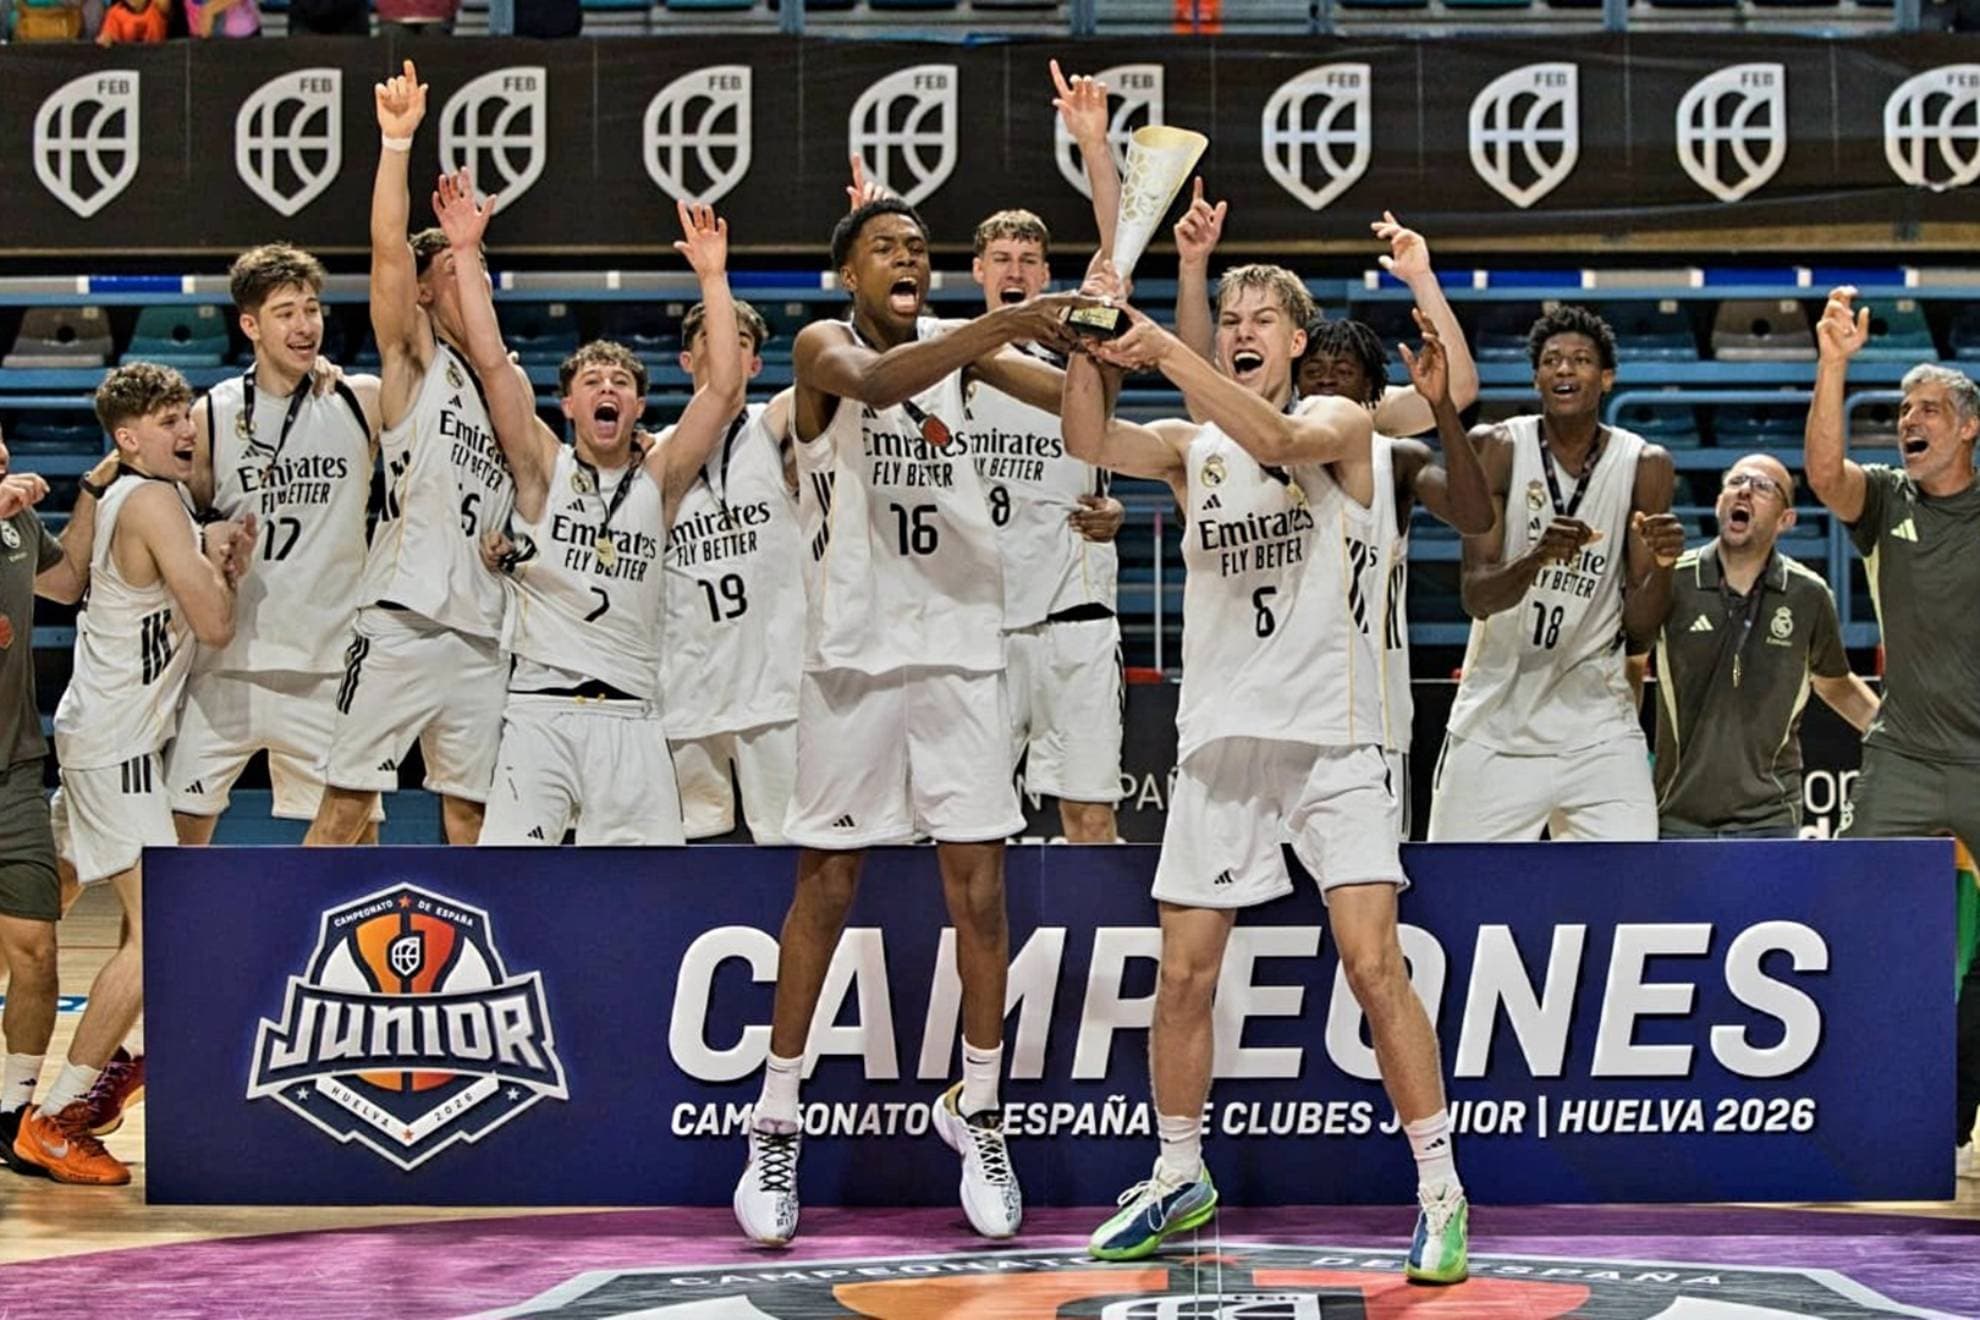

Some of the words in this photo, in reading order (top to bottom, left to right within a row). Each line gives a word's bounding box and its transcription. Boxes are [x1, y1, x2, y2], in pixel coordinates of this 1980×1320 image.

[97, 79, 130, 95] FEB
[299, 77, 333, 93] FEB
[503, 75, 537, 91] FEB
[708, 74, 742, 90] FEB
[914, 74, 948, 89] FEB
[1120, 73, 1154, 89] FEB
[1327, 73, 1361, 88] FEB
[1534, 72, 1568, 87] FEB
[1741, 71, 1775, 87] FEB
[969, 428, 1063, 458] mirates
[872, 461, 901, 486] FLY
[989, 457, 1044, 481] BETTER
[989, 485, 1010, 528] 8
[264, 516, 301, 561] 17
[552, 514, 656, 560] Emrates
[669, 502, 770, 546] mirates
[890, 502, 938, 556] 16
[564, 548, 593, 572] FLY
[677, 543, 697, 567] FLY
[703, 530, 757, 562] BETTER
[1221, 548, 1249, 577] FLY
[697, 573, 748, 622] 19
[1252, 586, 1277, 638] 6
[1533, 601, 1564, 650] 18
[334, 899, 394, 928] CAMPEONATO
[417, 899, 432, 912] DE
[331, 1086, 391, 1128] HUELVA
[434, 1092, 473, 1121] 2026
[671, 1102, 929, 1136] CAMONATO
[1003, 1095, 1151, 1136] ESPAÑA
[1221, 1101, 1372, 1135] CLUBES
[1379, 1100, 1524, 1135] JIOR
[1558, 1100, 1705, 1134] HUELVA
[1712, 1098, 1816, 1133] 2026
